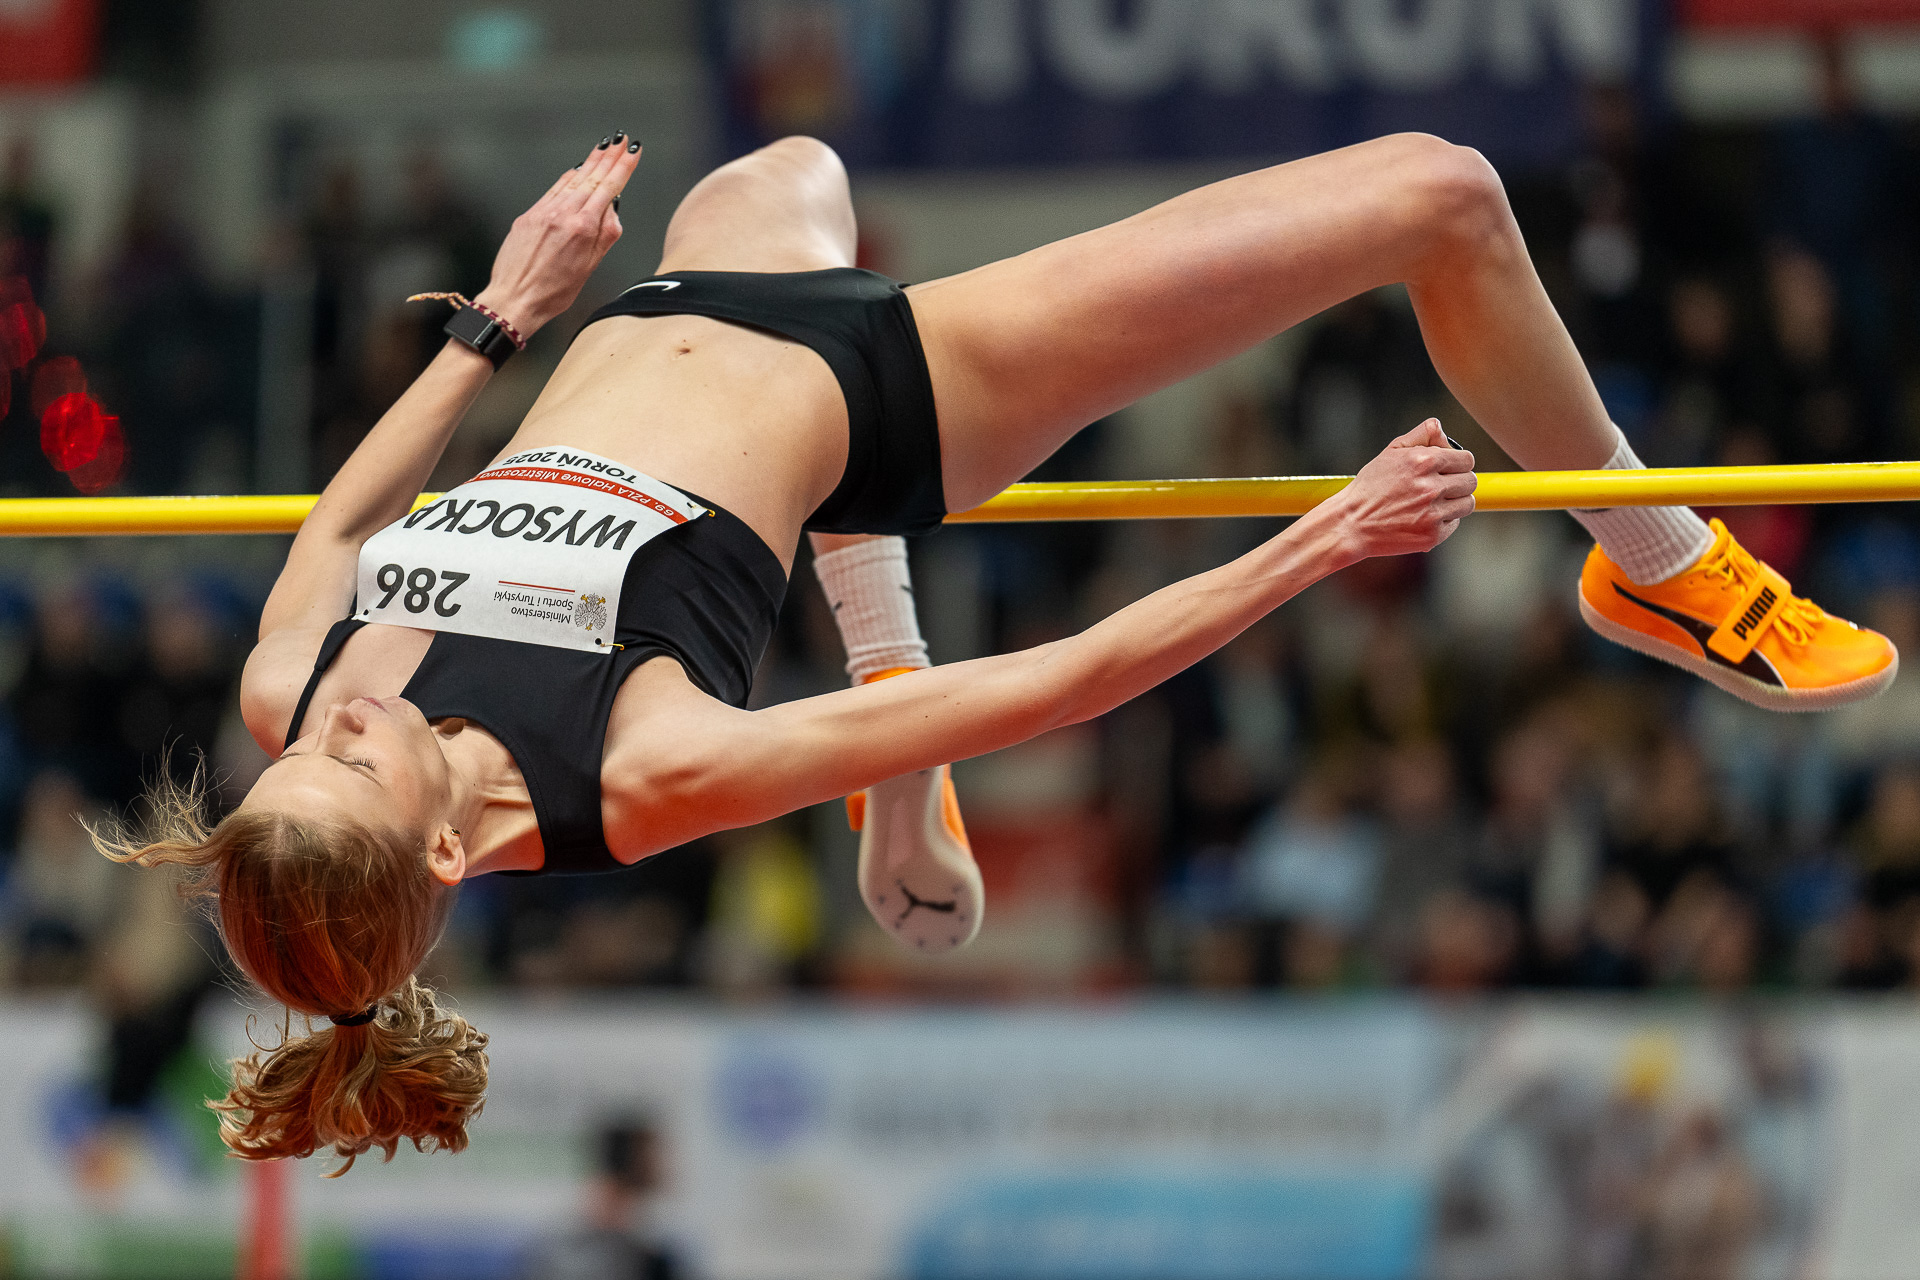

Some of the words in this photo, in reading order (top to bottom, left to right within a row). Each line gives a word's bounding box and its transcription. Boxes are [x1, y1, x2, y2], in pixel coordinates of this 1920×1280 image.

[505, 451, 558, 466] 2025
[557, 452, 638, 484] TORUŃ
[479, 469, 560, 482] Mistrzostwa
[560, 472, 616, 496] Halowe
[617, 485, 651, 504] PZLA
[649, 499, 675, 517] 69.
[402, 498, 638, 551] WYSOCKA
[375, 563, 471, 618] 286
[493, 590, 535, 606] Turystyki
[536, 597, 541, 606] i
[542, 597, 574, 611] Sportu
[510, 606, 572, 625] Ministerstwo
[1731, 586, 1778, 641] PUMA
